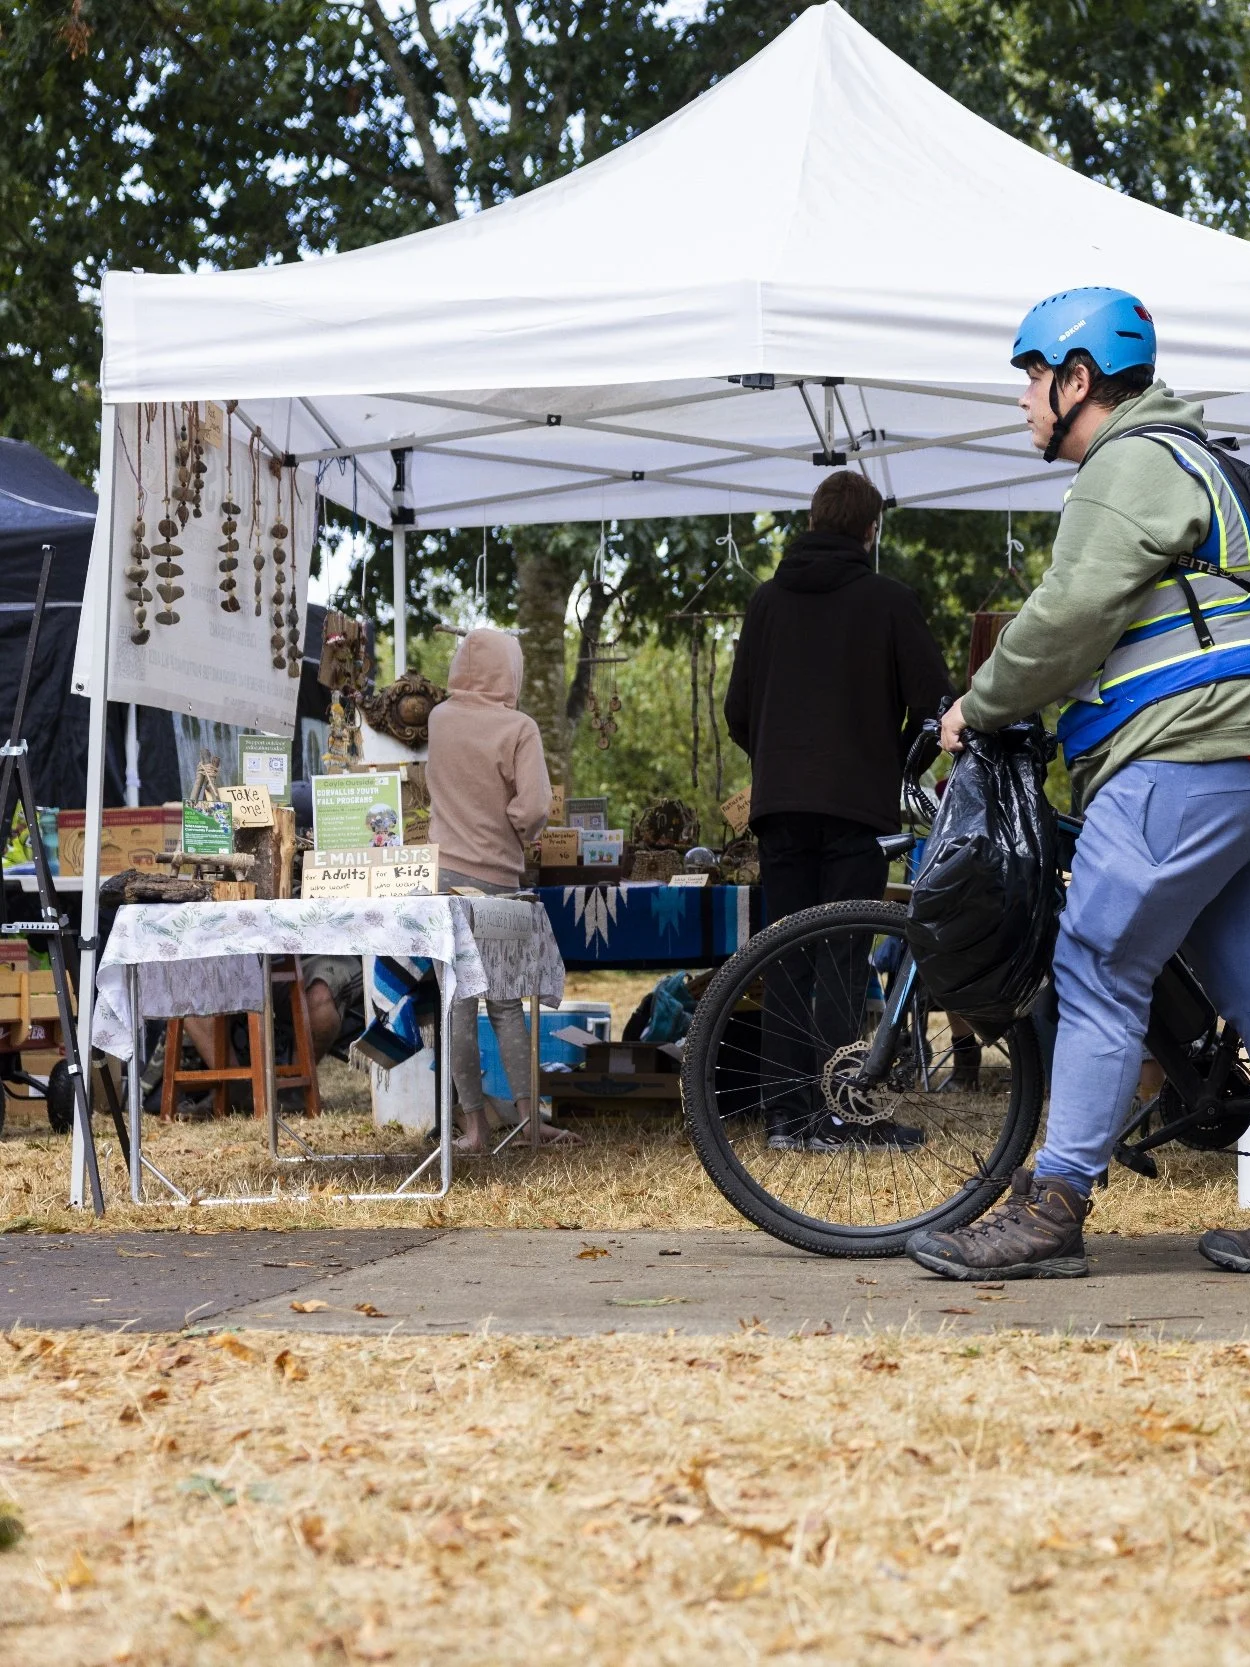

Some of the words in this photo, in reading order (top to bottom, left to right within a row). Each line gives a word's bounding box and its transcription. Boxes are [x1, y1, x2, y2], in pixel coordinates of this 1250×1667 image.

[227, 789, 260, 801] Take
[317, 788, 355, 797] CORVALLIS
[356, 787, 379, 795] YOUTH
[240, 800, 265, 816] one!
[317, 798, 335, 806] FALL
[337, 797, 374, 805] PROGRAMS
[382, 848, 432, 864] LISTS
[322, 868, 366, 881] Adults
[394, 865, 430, 878] Kids
